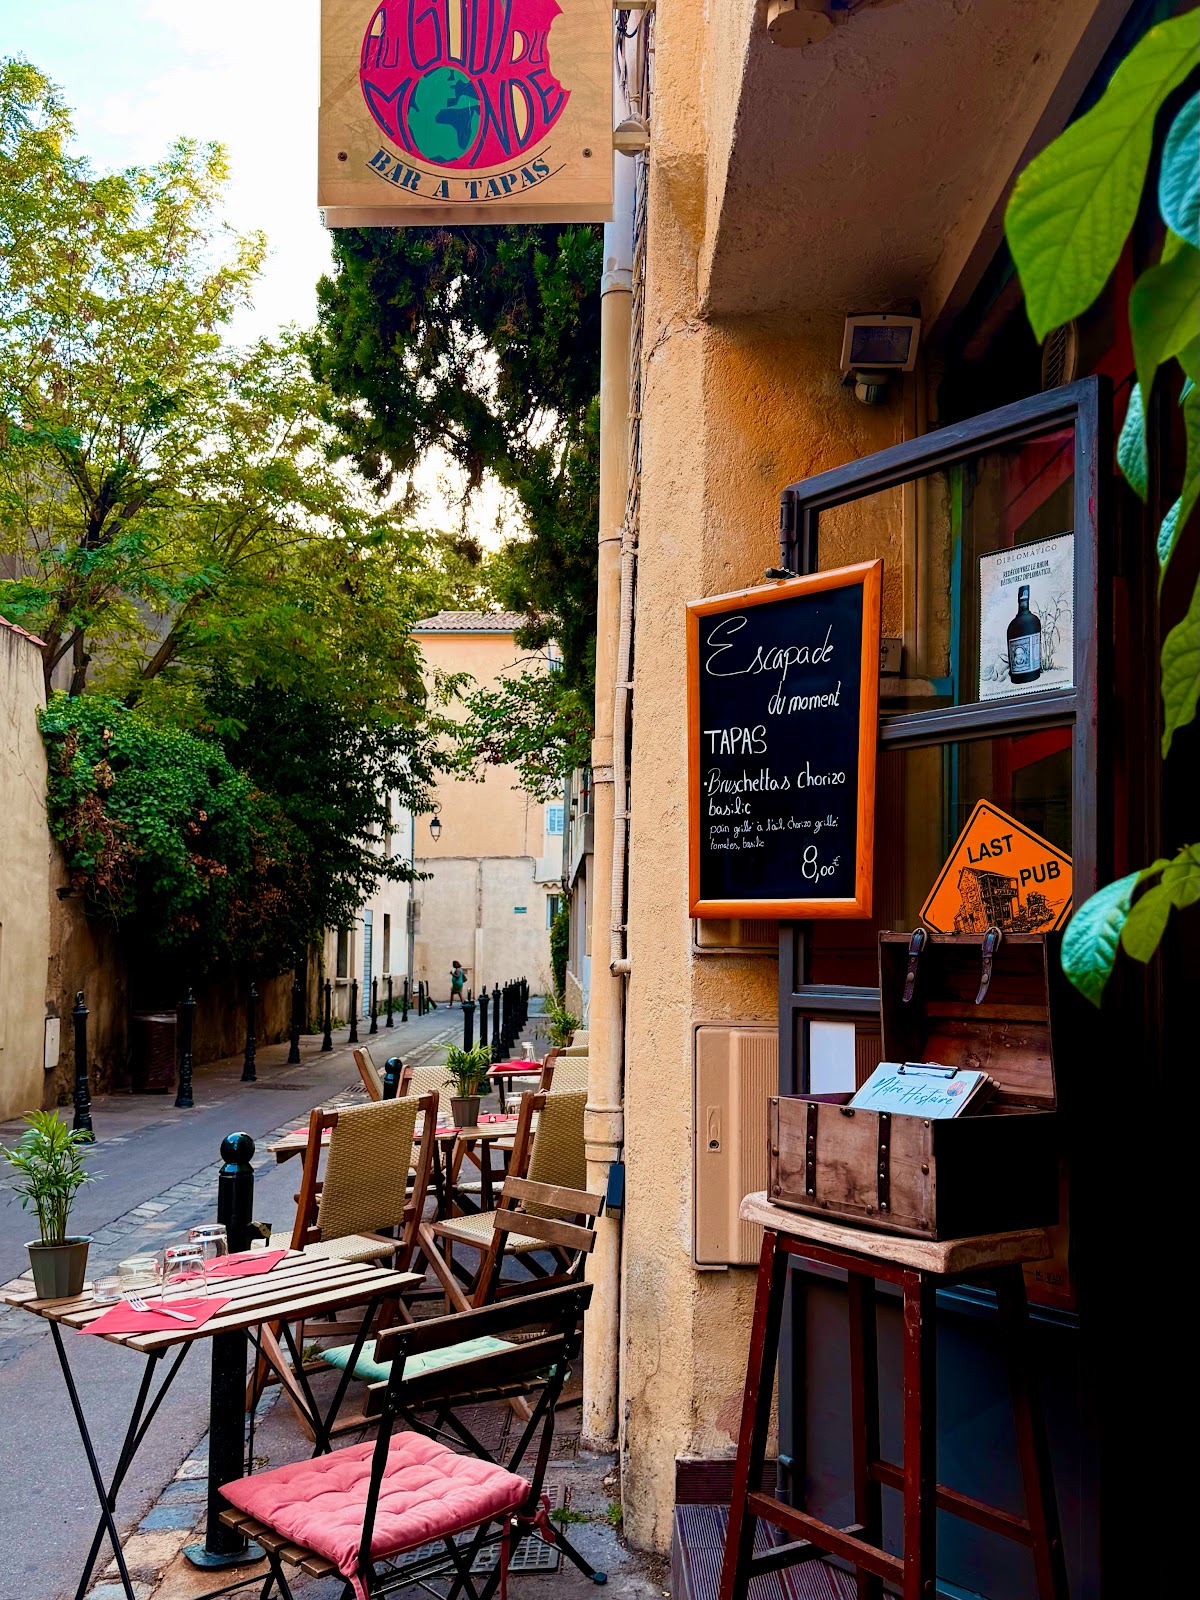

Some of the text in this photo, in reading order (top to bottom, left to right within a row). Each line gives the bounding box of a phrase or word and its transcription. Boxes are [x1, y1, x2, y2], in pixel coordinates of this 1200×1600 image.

[509, 29, 546, 64] DU
[368, 148, 551, 200] BAR A TAPAS
[705, 615, 834, 681] Escapade
[768, 680, 841, 715] du moment
[703, 724, 768, 755] TAPAS
[708, 796, 752, 816] basilic
[709, 824, 730, 839] pain
[742, 835, 765, 849] basilic
[966, 833, 1014, 864] LAST
[1019, 860, 1061, 888] PUB
[872, 1076, 904, 1098] Notre
[899, 1084, 954, 1106] Histoire
